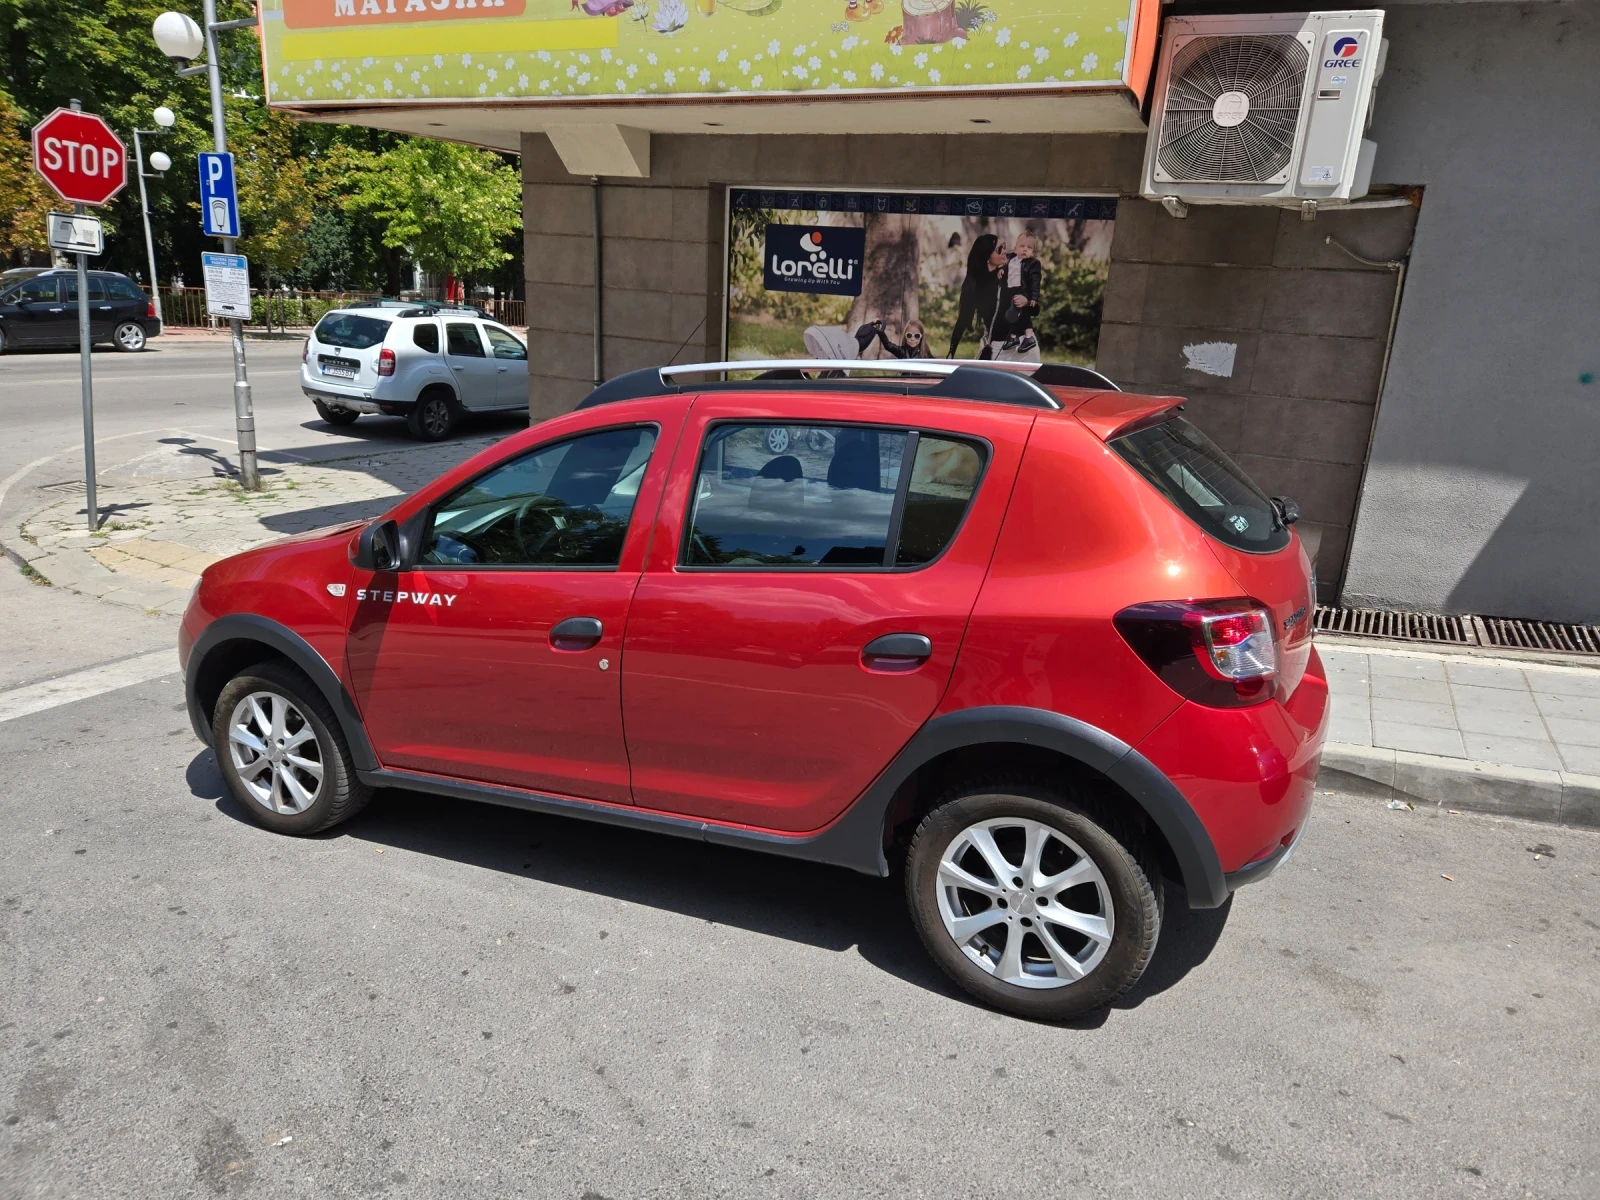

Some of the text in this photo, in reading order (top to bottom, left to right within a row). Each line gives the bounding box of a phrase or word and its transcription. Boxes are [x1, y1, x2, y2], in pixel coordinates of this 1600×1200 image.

[1324, 59, 1362, 68] GREE
[44, 137, 118, 178] STOP
[208, 156, 222, 194] P
[784, 276, 807, 284] Growing
[357, 589, 457, 606] STEPWAY
